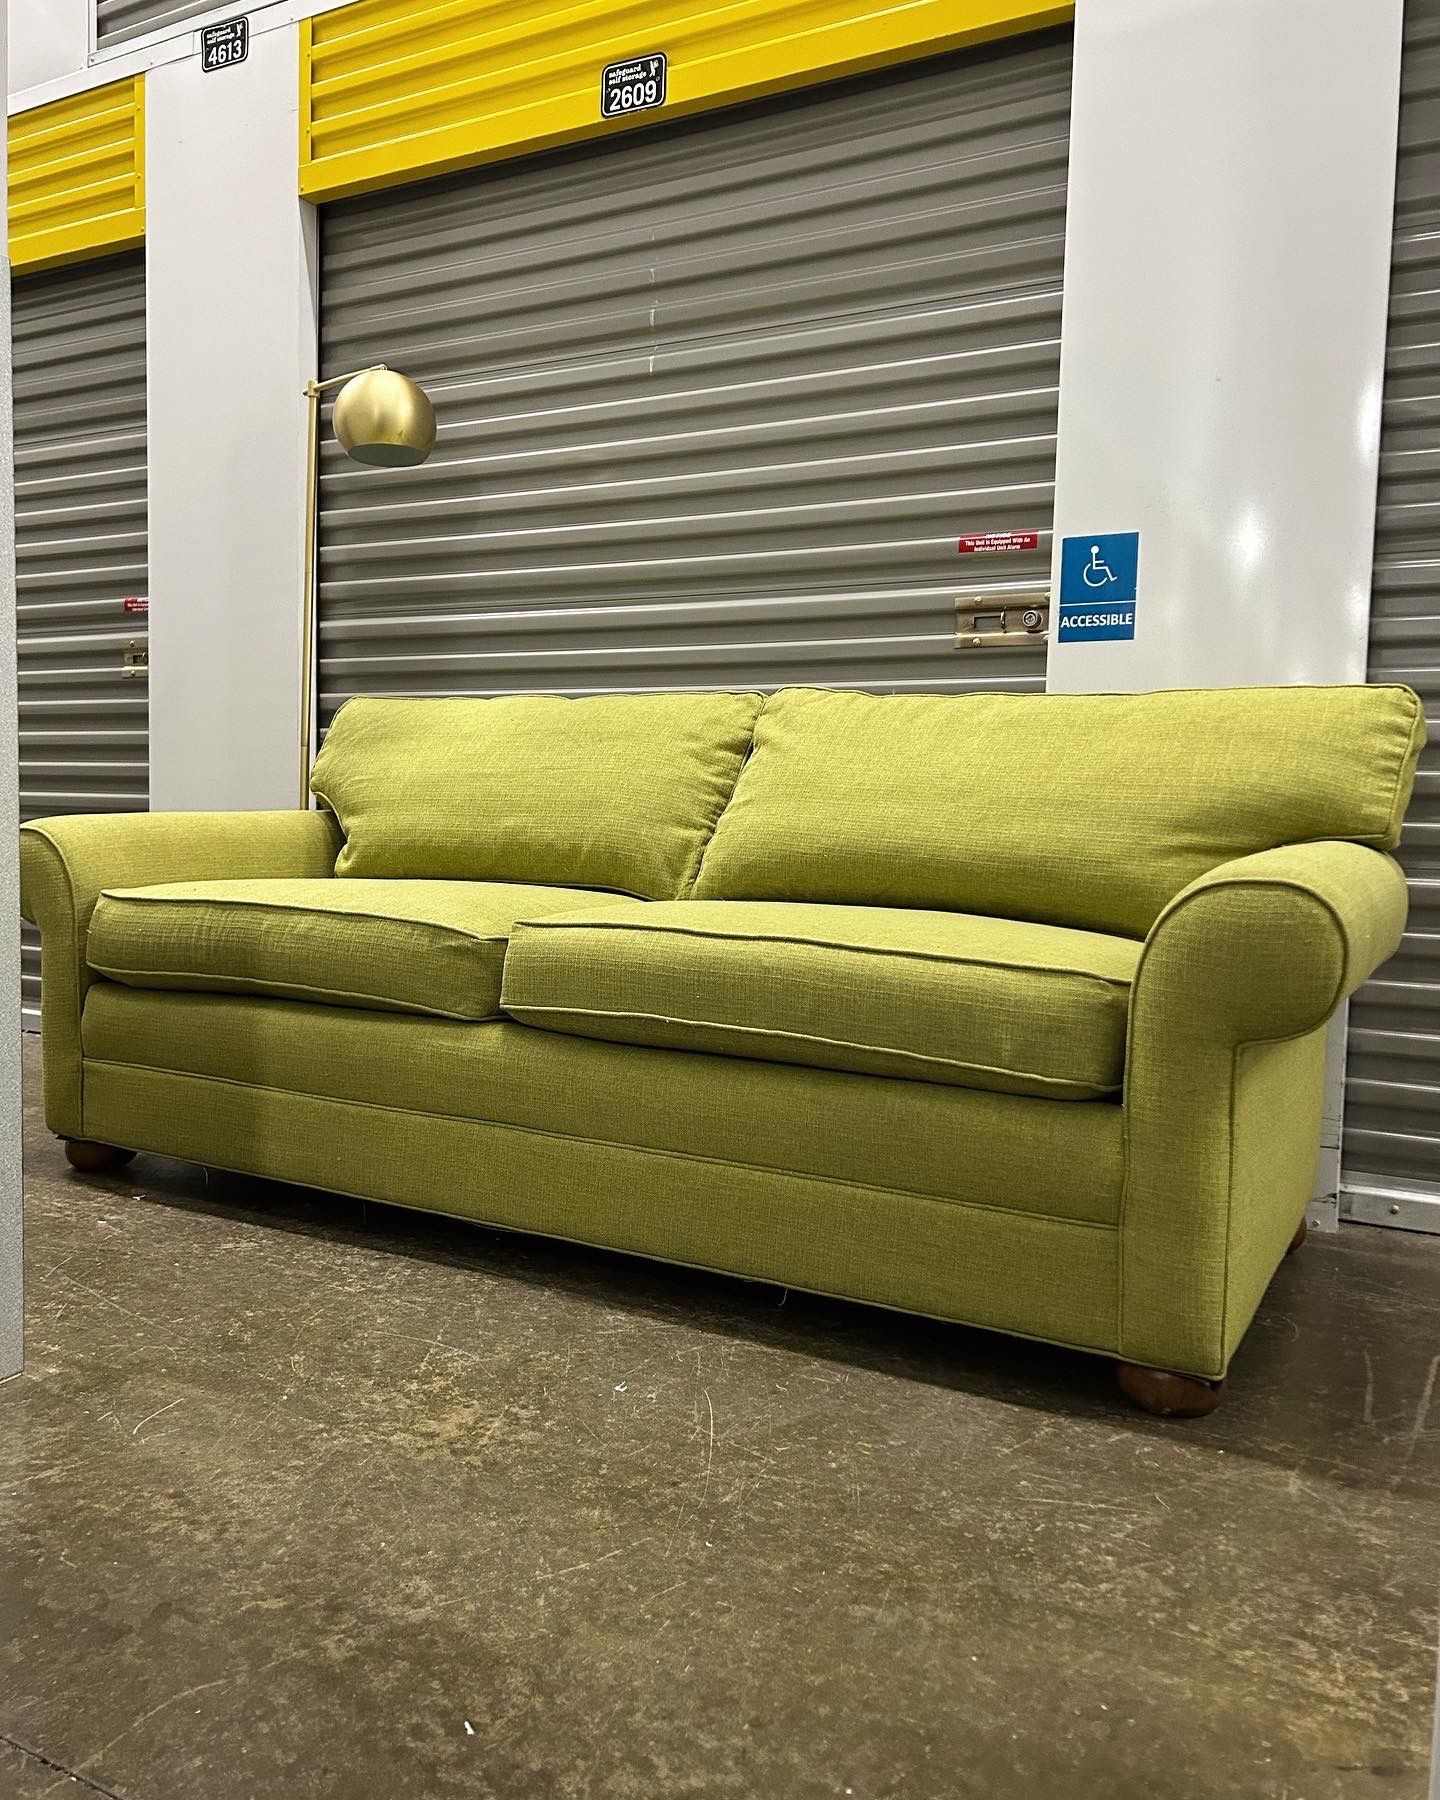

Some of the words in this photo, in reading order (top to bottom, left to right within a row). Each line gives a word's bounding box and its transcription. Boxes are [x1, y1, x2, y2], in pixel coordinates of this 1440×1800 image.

[208, 39, 242, 65] 4613
[608, 63, 641, 78] safeguard
[608, 75, 621, 85] self
[621, 71, 647, 82] storage
[609, 80, 656, 111] 2609
[1060, 613, 1133, 628] ACCESSIBLE
